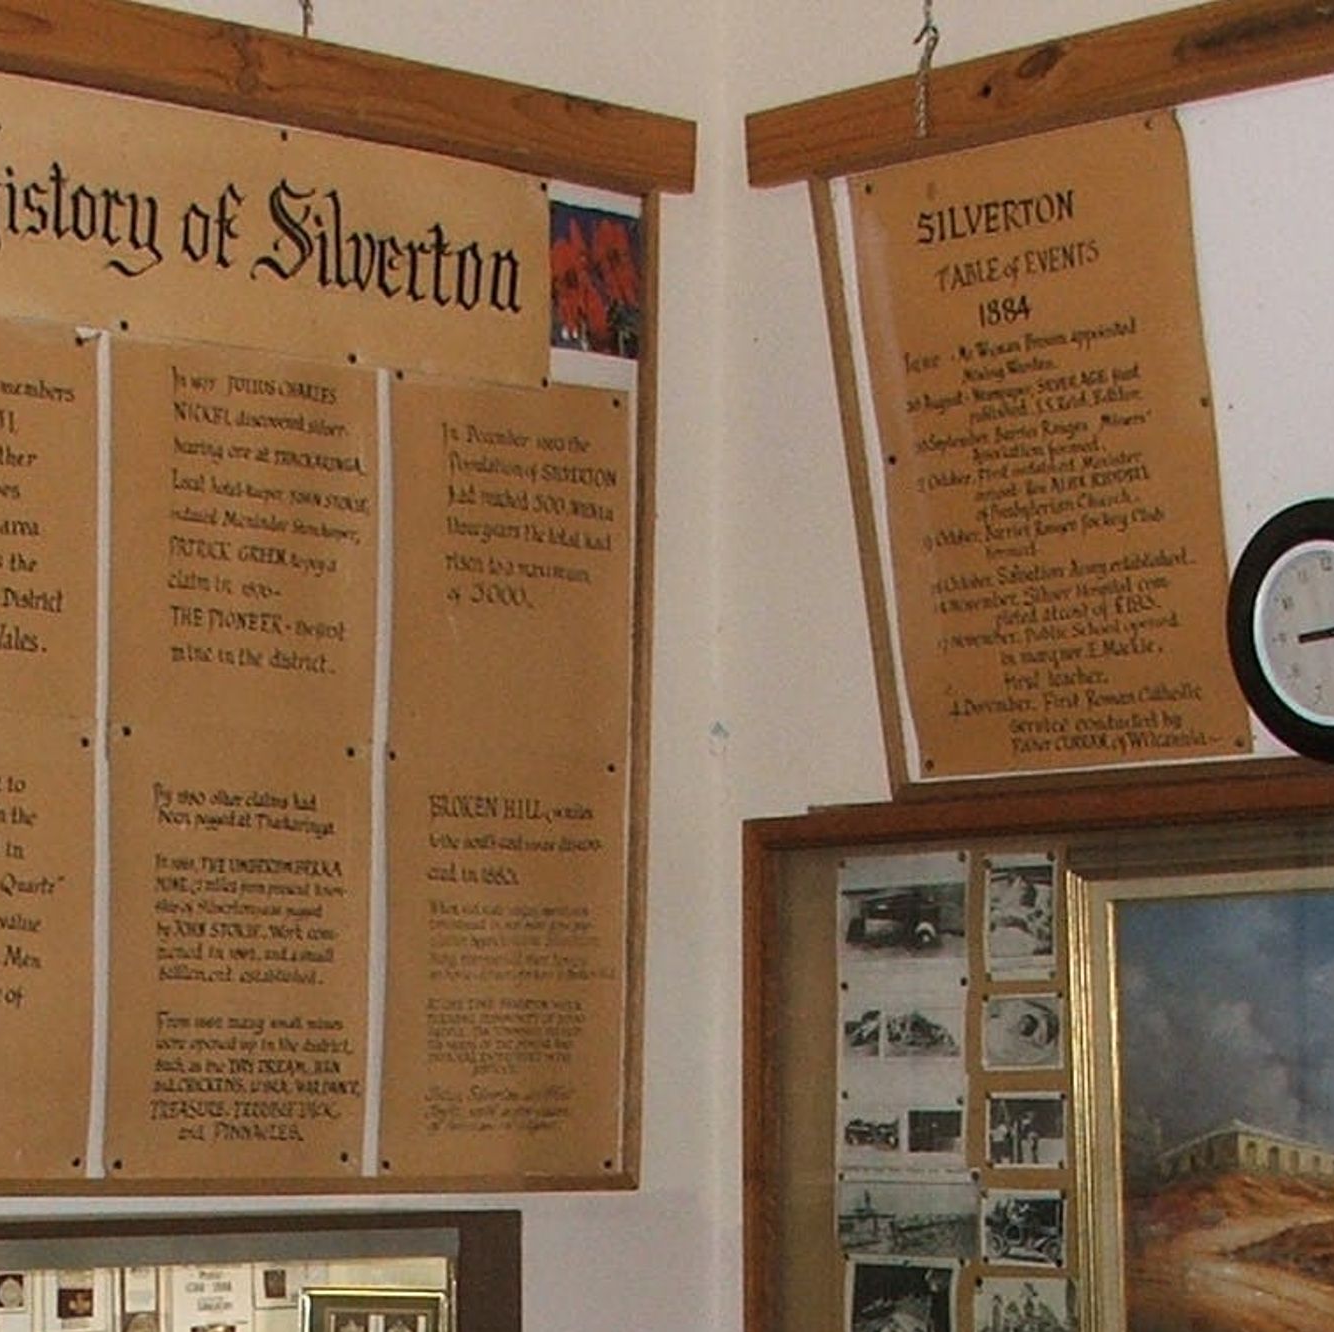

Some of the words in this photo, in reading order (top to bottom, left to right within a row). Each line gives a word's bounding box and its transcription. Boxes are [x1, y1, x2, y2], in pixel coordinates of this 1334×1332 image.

[917, 189, 1075, 245] SILVERTON
[181, 202, 241, 269] of
[253, 186, 523, 313] Silverton
[935, 256, 1000, 293] TABLE
[1003, 256, 1021, 287] of
[1026, 239, 1100, 276] EVENTS
[979, 295, 1032, 328] 1884
[170, 605, 203, 628] THE
[7, 776, 26, 794] to
[11, 807, 38, 826] the
